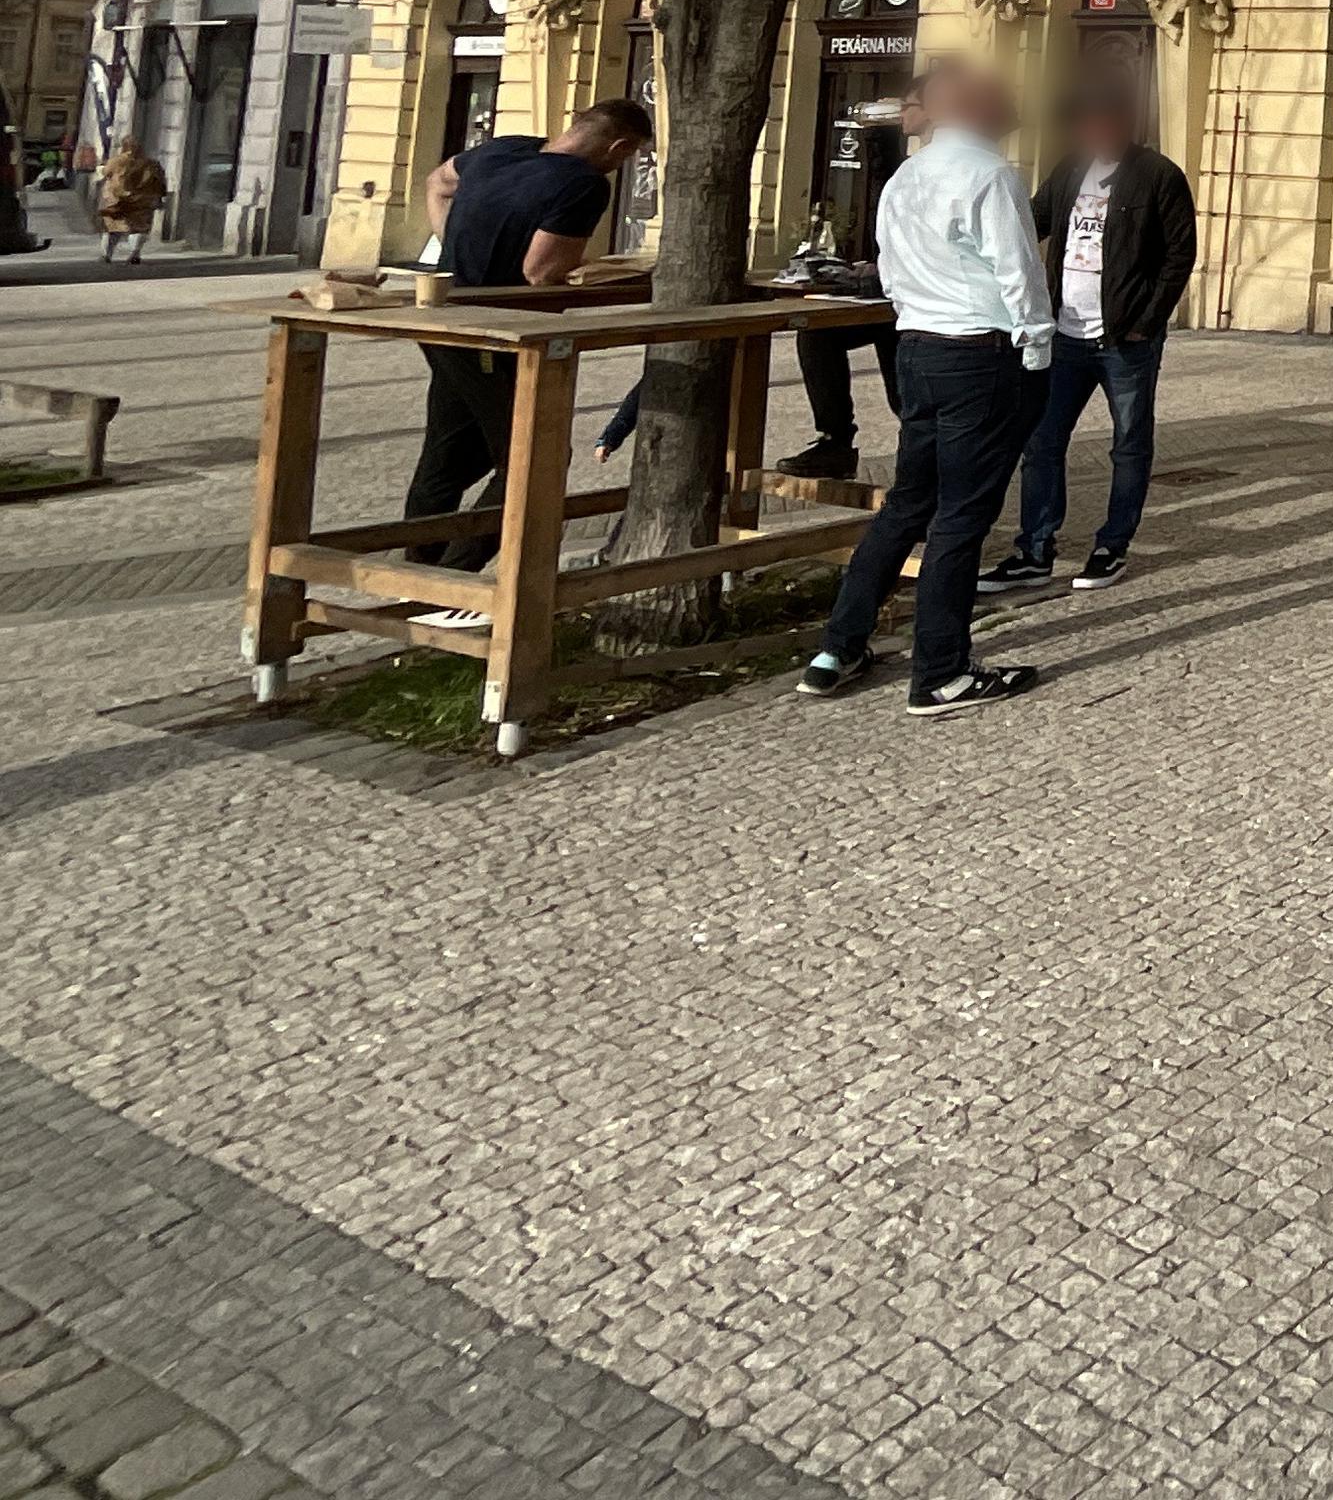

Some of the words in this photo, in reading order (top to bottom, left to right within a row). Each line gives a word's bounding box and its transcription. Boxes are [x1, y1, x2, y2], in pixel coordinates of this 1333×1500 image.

[830, 34, 886, 55] PEKÁRNA
[886, 37, 913, 54] HSH
[1074, 215, 1105, 233] VANS
